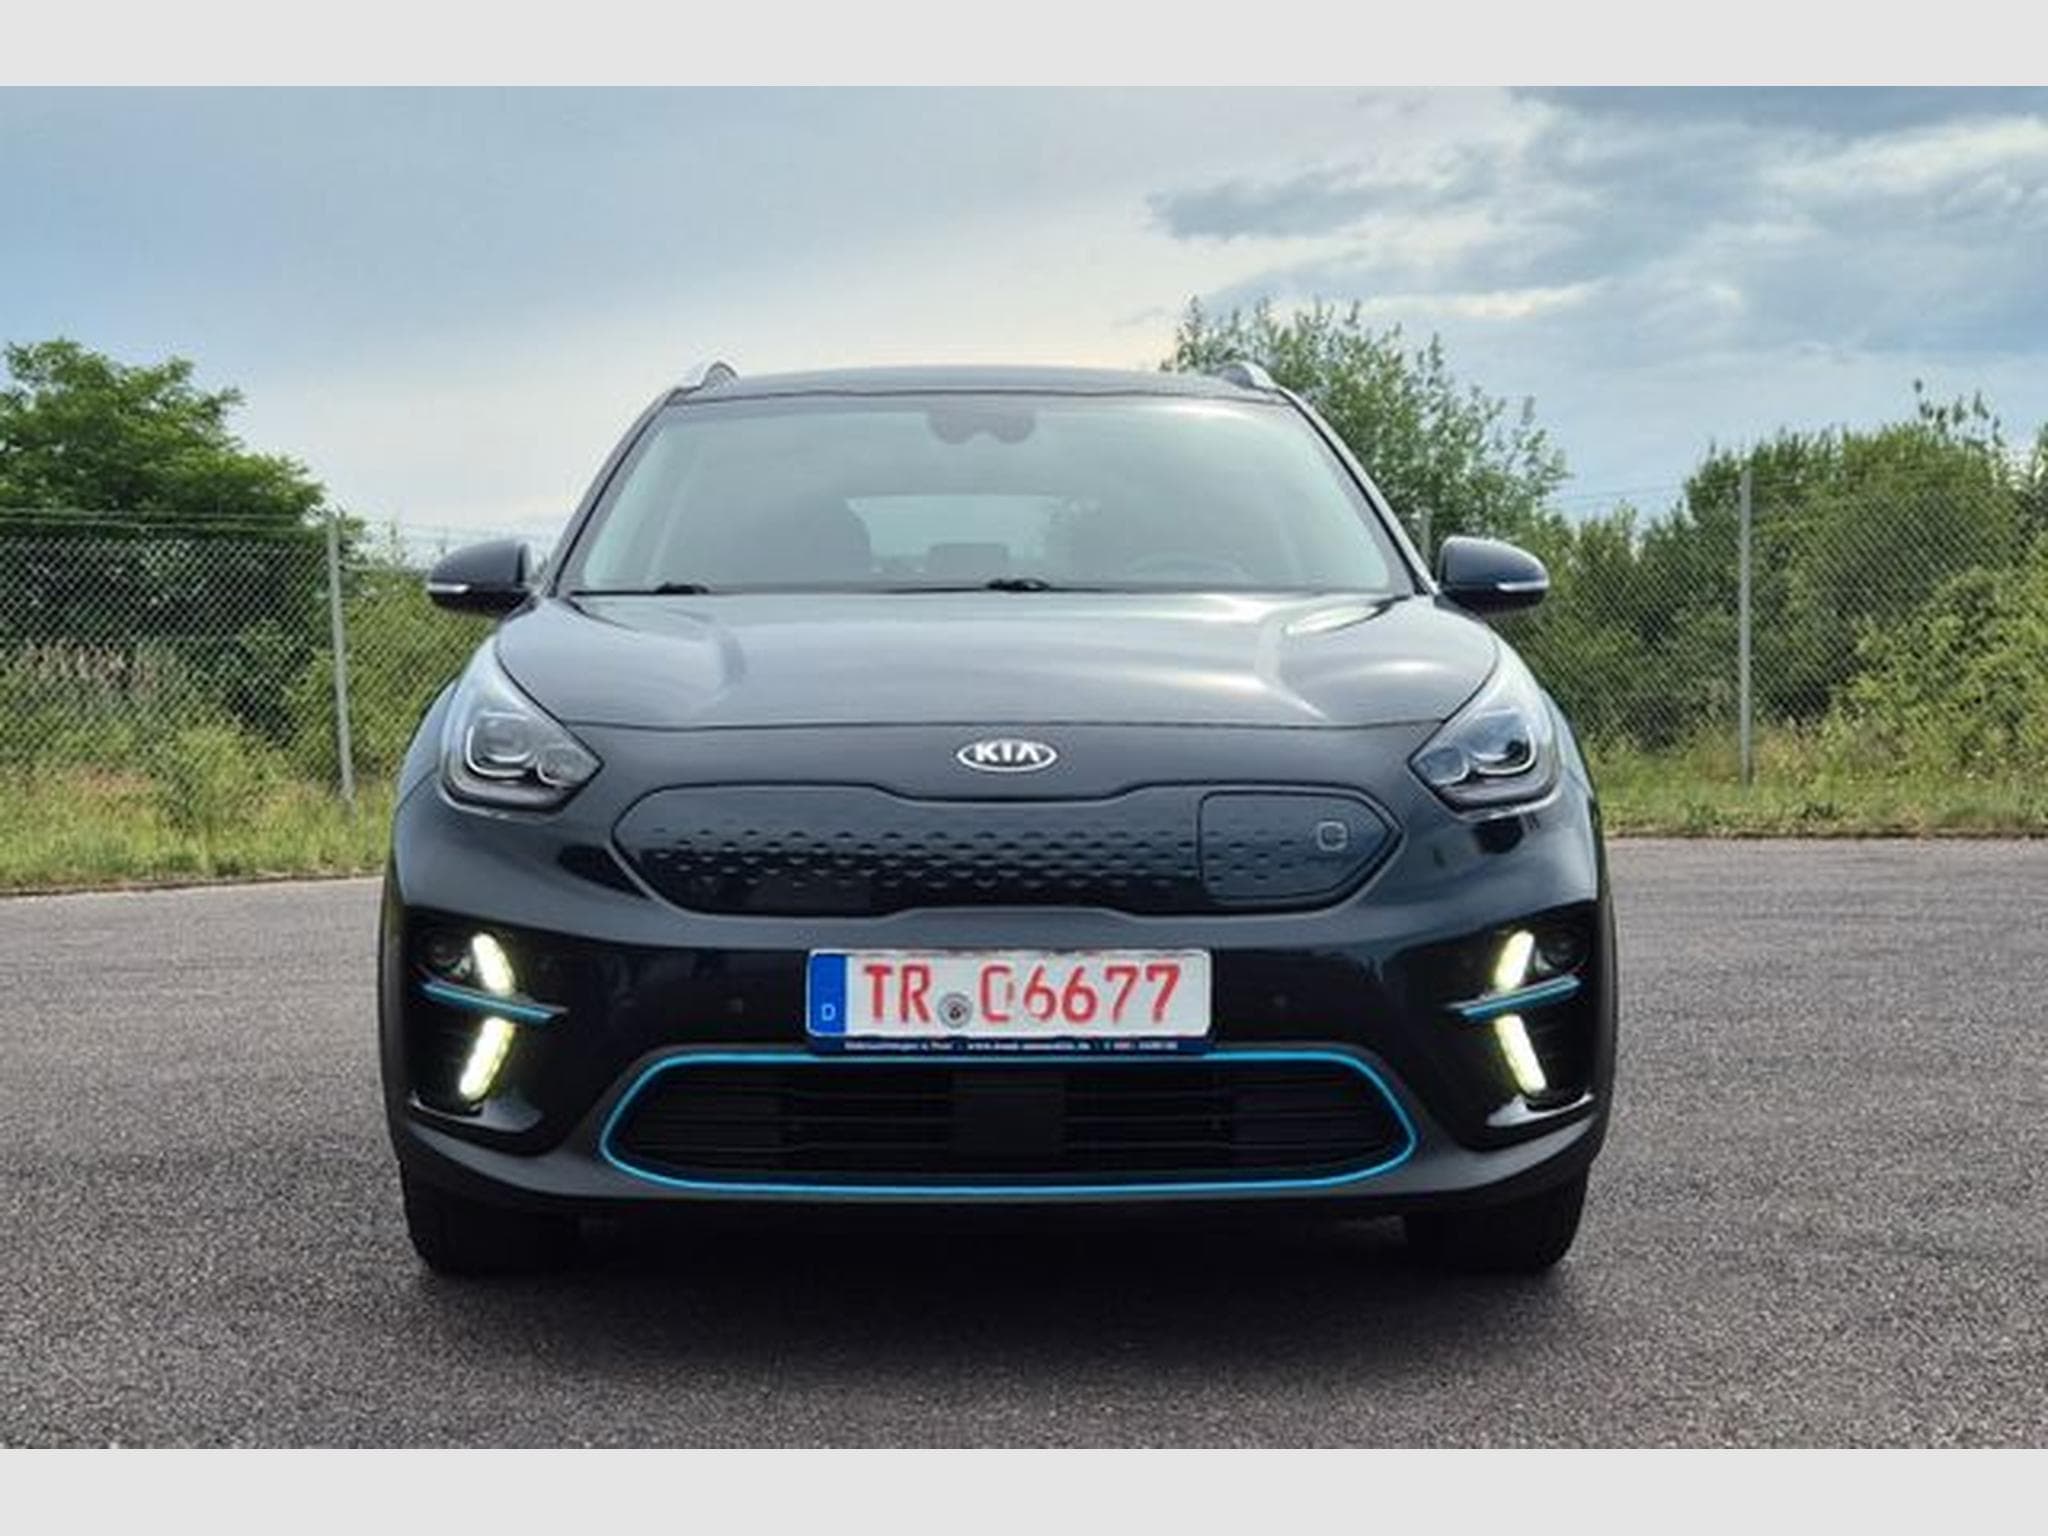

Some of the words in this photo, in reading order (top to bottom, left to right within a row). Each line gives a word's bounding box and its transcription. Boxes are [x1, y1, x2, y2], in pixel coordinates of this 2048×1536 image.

[976, 742, 1040, 763] KIA
[863, 964, 932, 1023] TR
[821, 1005, 836, 1021] D
